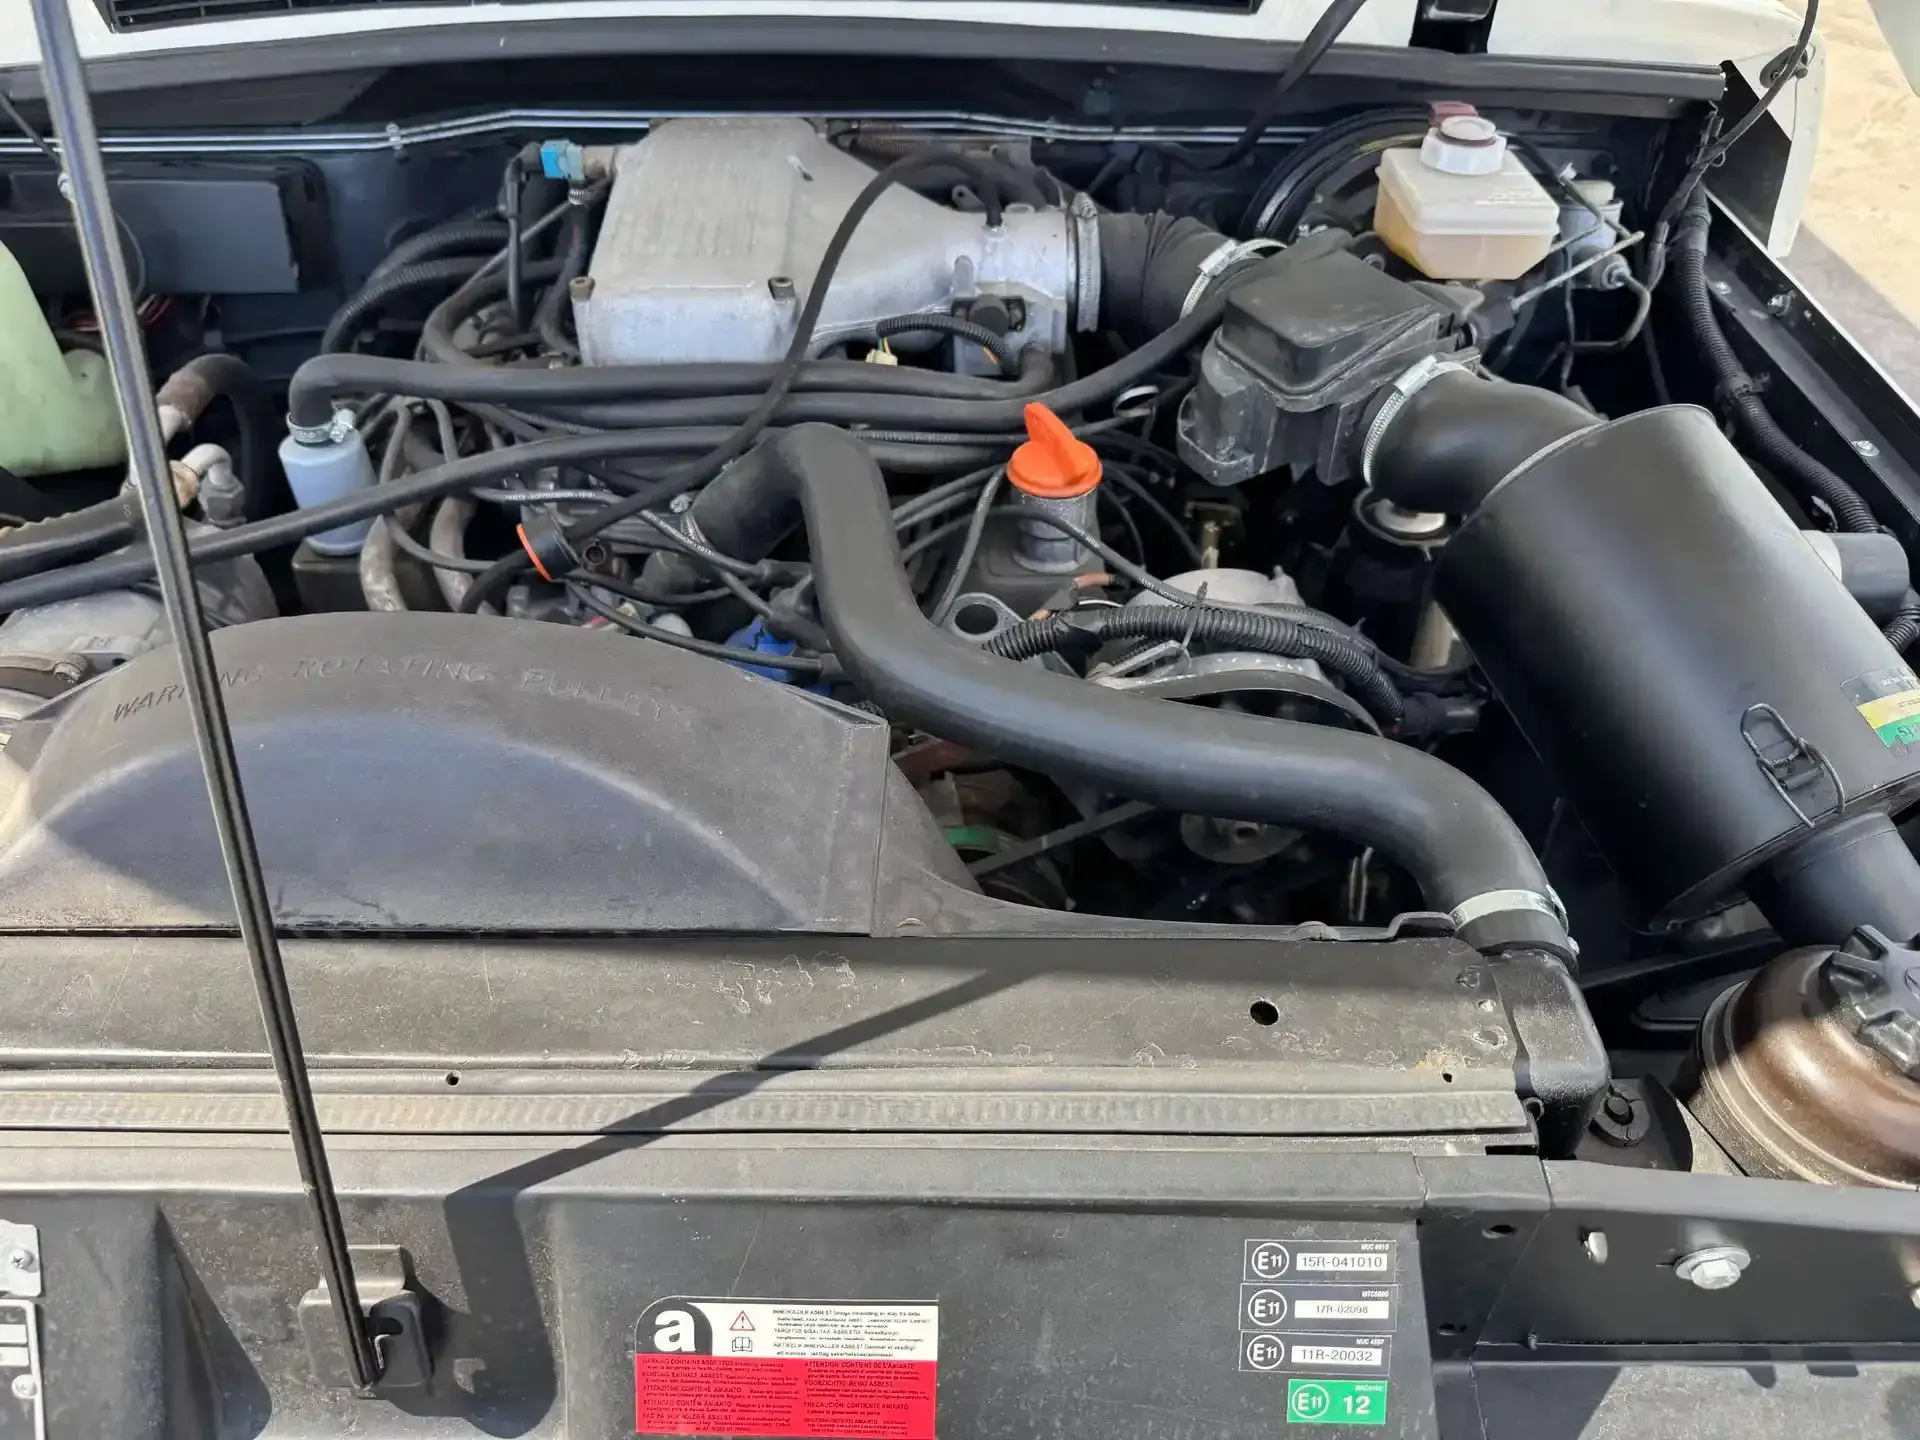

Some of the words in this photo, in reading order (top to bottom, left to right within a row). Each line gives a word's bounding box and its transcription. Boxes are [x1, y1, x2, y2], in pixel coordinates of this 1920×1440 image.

[1302, 1256, 1383, 1268] 15R-041010
[1315, 1304, 1369, 1314] 17R-02098
[653, 1309, 696, 1353] a
[1301, 1349, 1373, 1362] 11R-20032
[1343, 1395, 1371, 1415] 12
